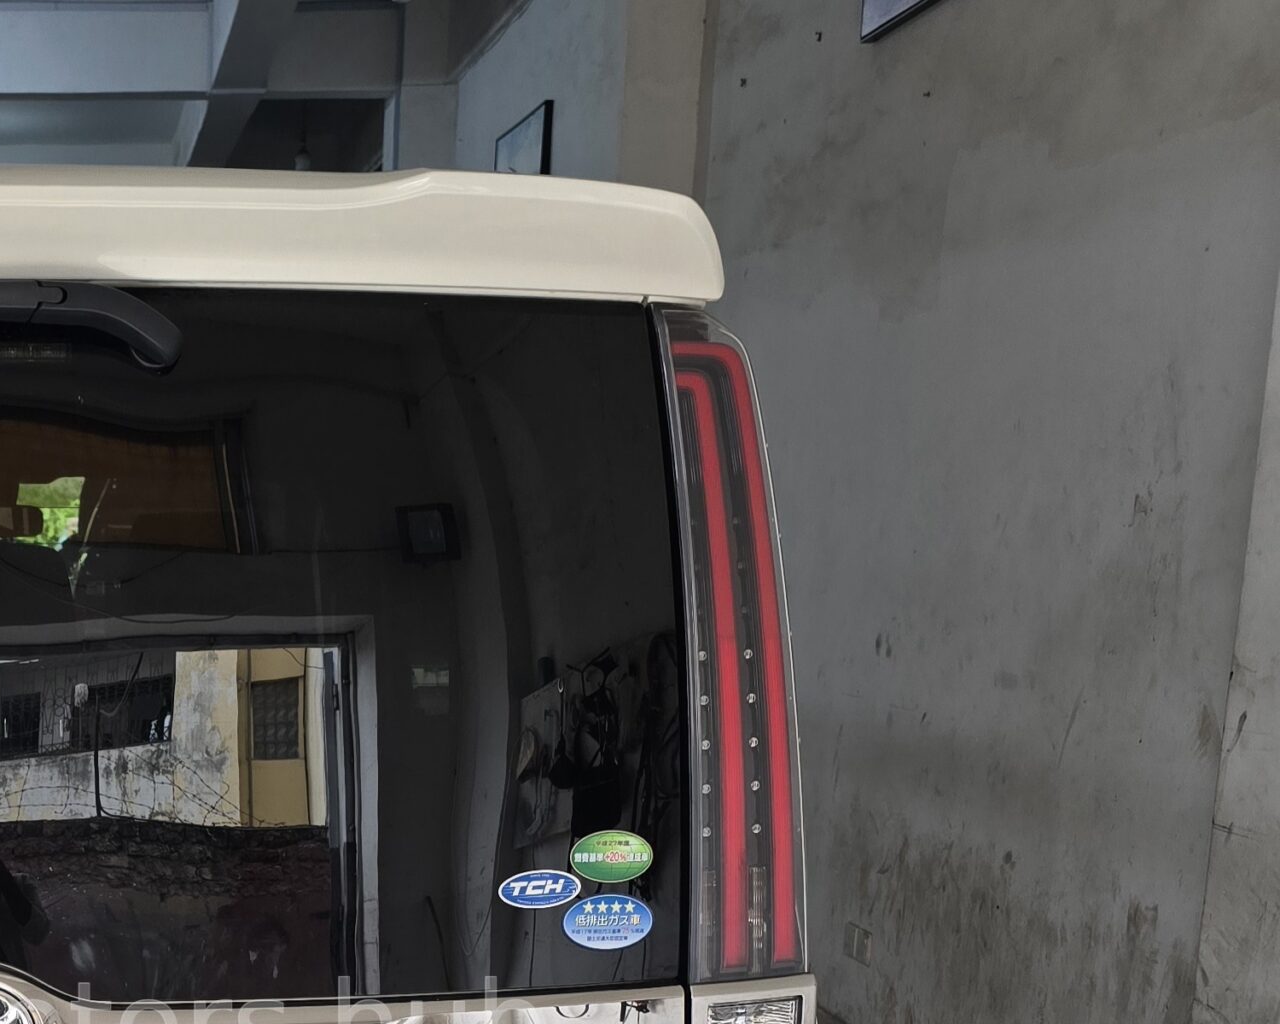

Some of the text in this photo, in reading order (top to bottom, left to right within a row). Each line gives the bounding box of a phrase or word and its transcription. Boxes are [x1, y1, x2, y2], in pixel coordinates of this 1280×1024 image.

[509, 878, 565, 896] TCH
[575, 914, 641, 926] 低排出ガス車
